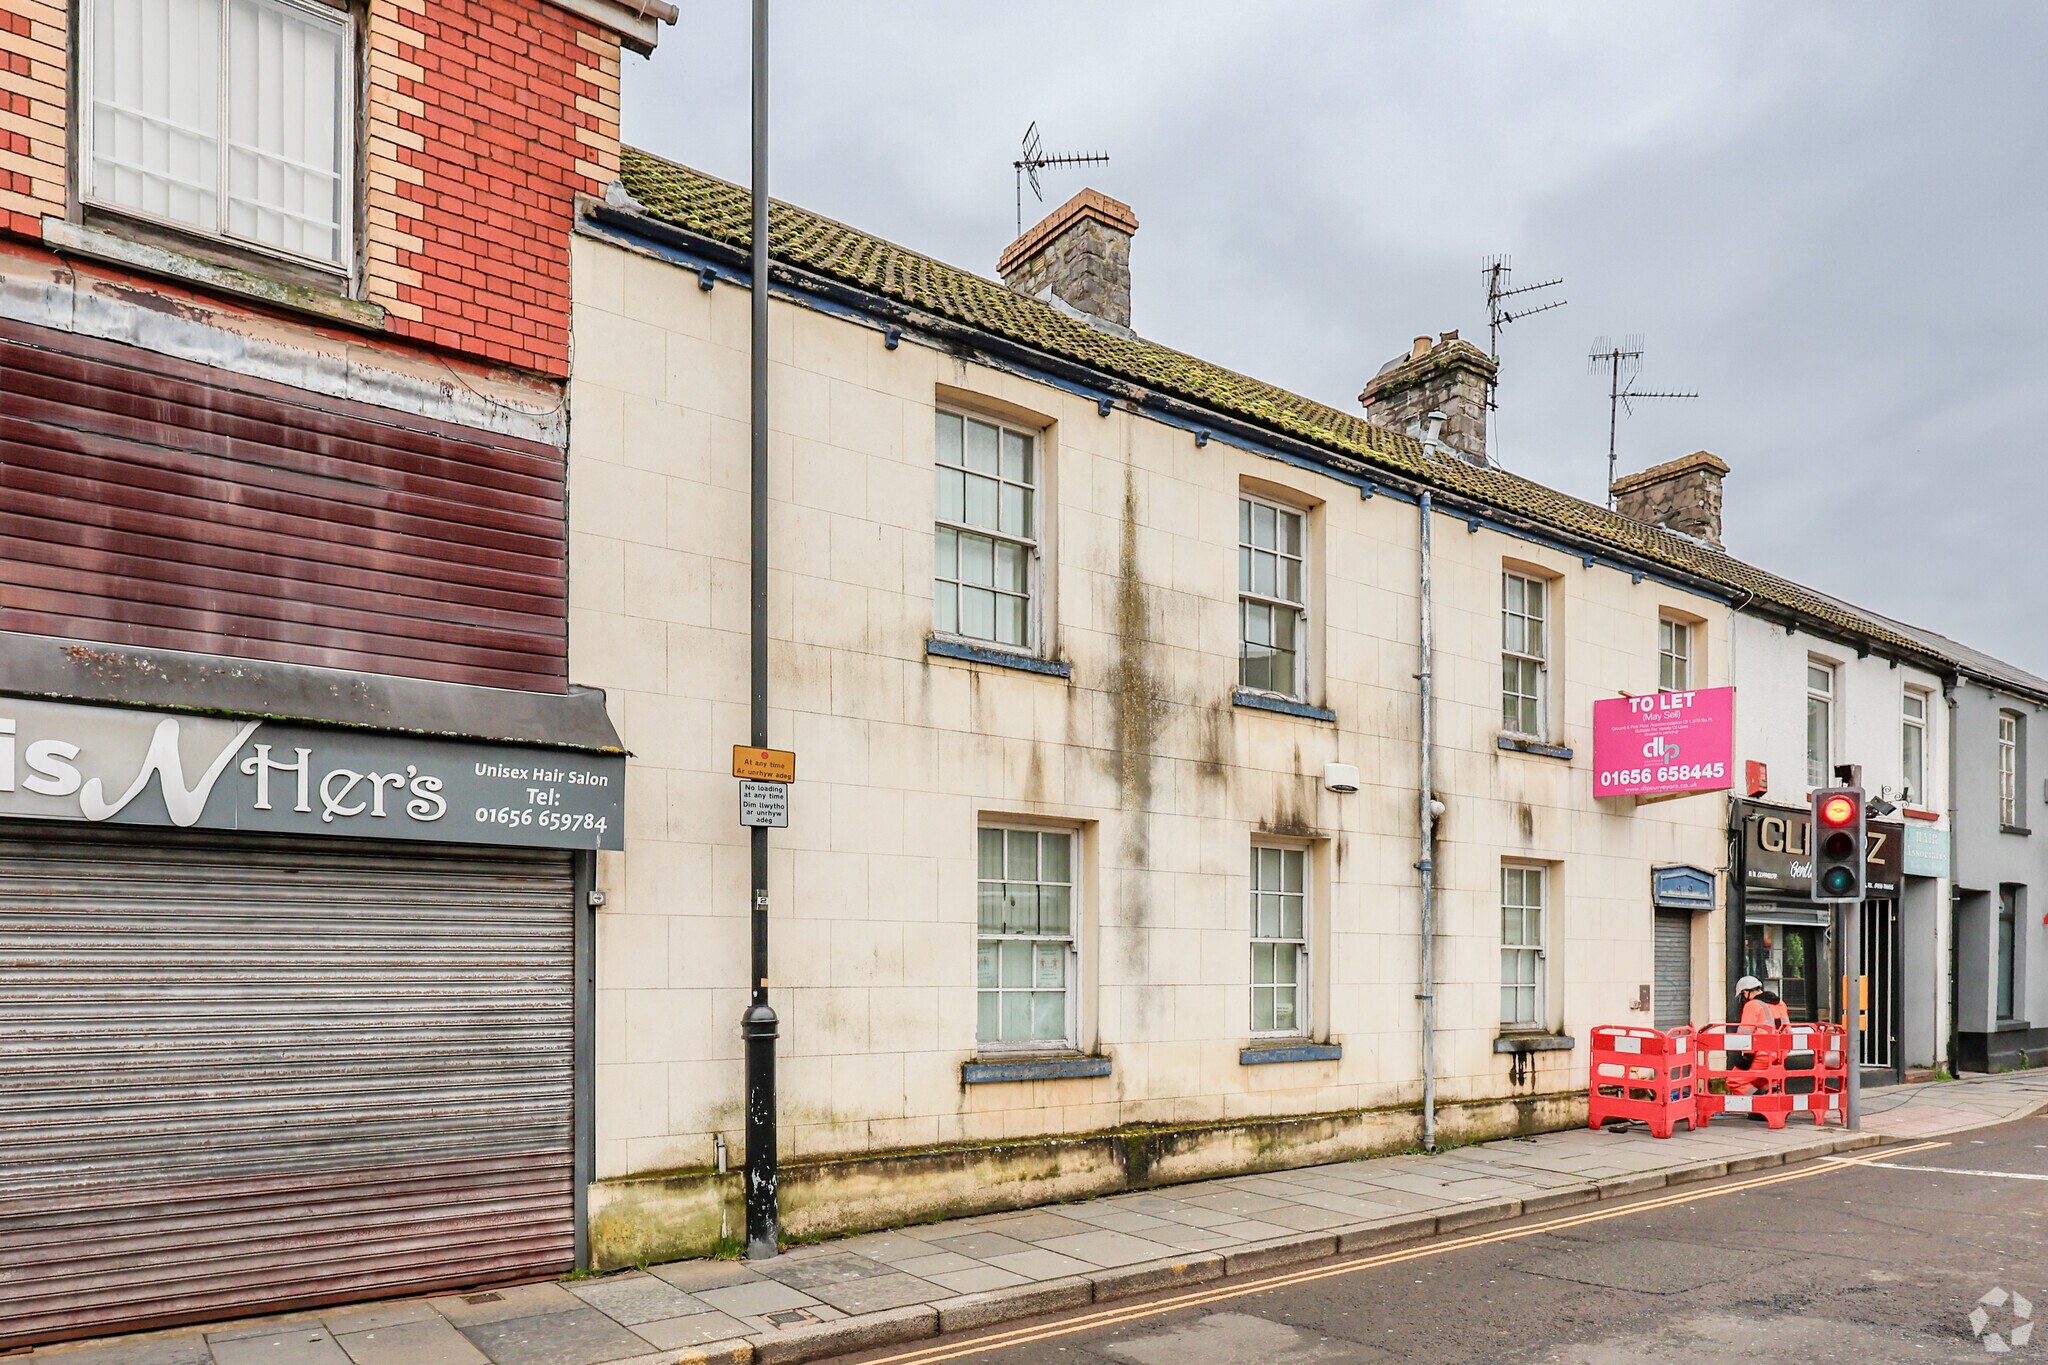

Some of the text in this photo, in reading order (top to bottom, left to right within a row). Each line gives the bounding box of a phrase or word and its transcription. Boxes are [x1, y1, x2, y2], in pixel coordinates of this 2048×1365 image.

[1629, 692, 1696, 713] TO LET
[1642, 710, 1681, 722] (May Sell)
[1643, 736, 1680, 764] dlp
[744, 758, 753, 766] At
[79, 718, 264, 828] N
[474, 762, 608, 787] Unisex Hair Salon
[748, 769, 773, 777] unrhyw
[1600, 762, 1725, 787] 01656 658445
[526, 788, 560, 806] Tel:
[758, 785, 783, 793] loading
[1625, 782, 1698, 793] www.dlpsurveyors.co.uk
[759, 802, 785, 810] llwytho
[475, 807, 608, 834] 01656 659784
[1761, 816, 1887, 865] CLIZ
